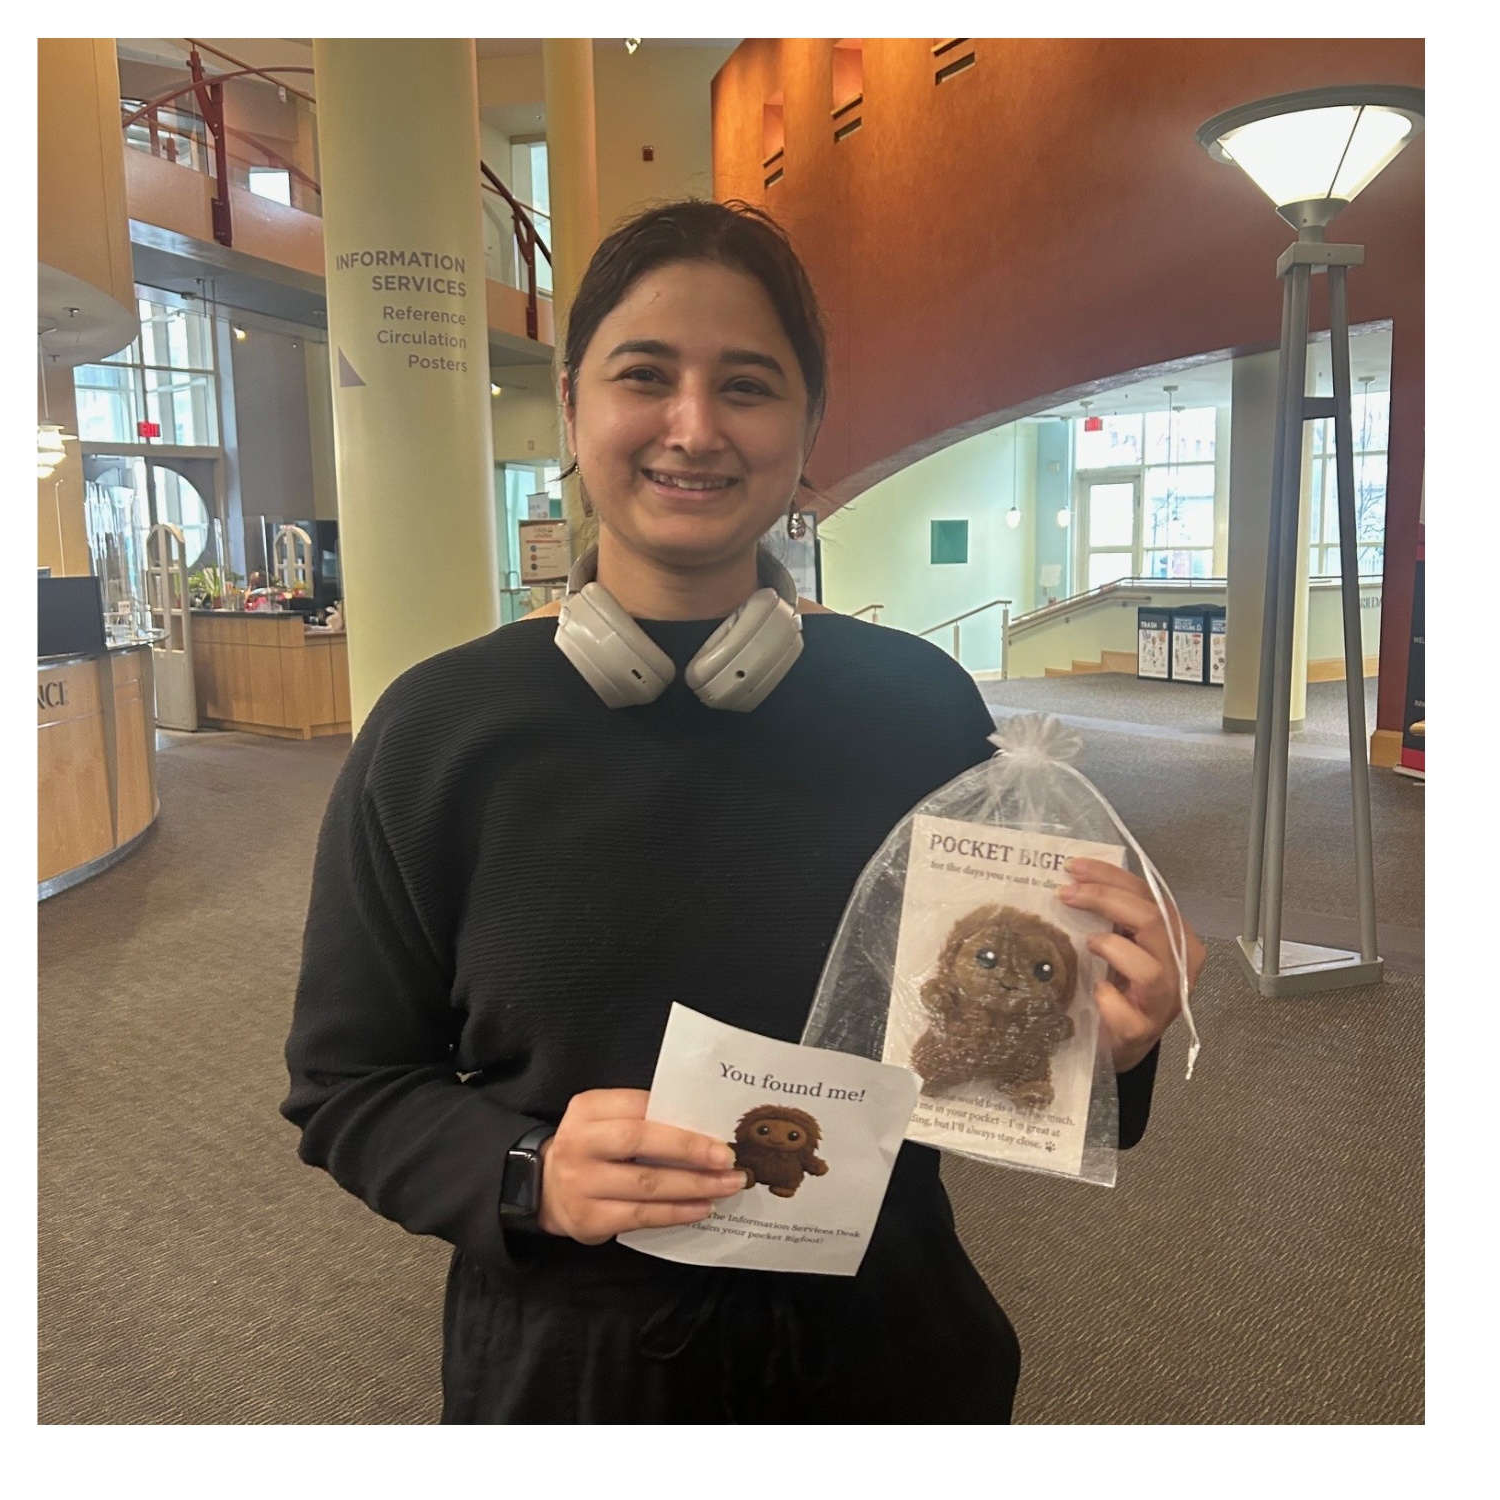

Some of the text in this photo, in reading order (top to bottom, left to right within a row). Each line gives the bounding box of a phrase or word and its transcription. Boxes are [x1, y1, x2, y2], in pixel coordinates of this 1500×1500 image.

[336, 250, 465, 273] INFORMATION
[372, 275, 467, 297] SERVICES
[383, 306, 466, 325] Reference
[377, 330, 467, 349] Circulation
[408, 354, 468, 372] Posters
[1141, 621, 1158, 629] TRASH
[929, 834, 1074, 871] POCKET BIGF
[930, 861, 944, 870] for
[946, 862, 961, 872] the
[962, 864, 985, 878] days
[986, 871, 1003, 881] you
[1005, 873, 1030, 885] want
[720, 1062, 866, 1102] You found me!
[919, 1102, 934, 1111] me
[935, 1104, 945, 1113] in
[946, 1107, 968, 1118] your
[969, 1111, 1000, 1124] pocket
[1026, 1123, 1050, 1136] great
[1051, 1128, 1061, 1138] at
[1046, 1114, 1075, 1126] much.
[934, 1117, 950, 1129] but
[966, 1124, 995, 1140] always
[997, 1133, 1015, 1145] stay
[1016, 1136, 1042, 1149] close.
[692, 1224, 721, 1233] claim
[747, 1231, 782, 1241] pocket
[785, 1235, 824, 1245] Bigfoot!
[707, 1212, 860, 1238] The Information Services Desk
